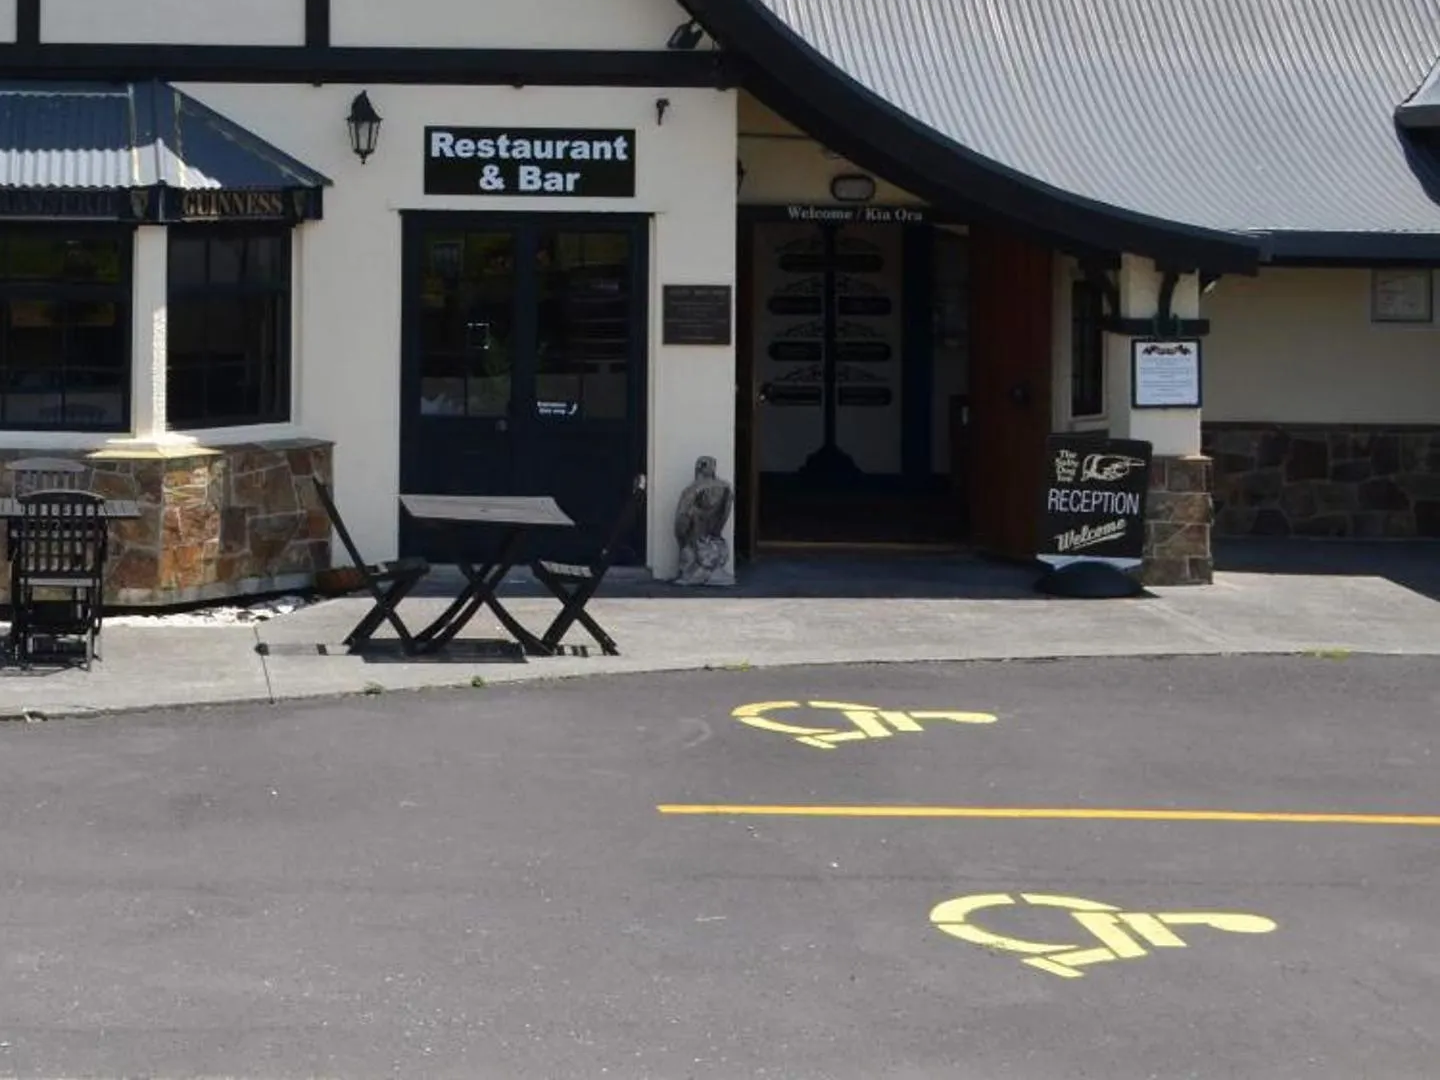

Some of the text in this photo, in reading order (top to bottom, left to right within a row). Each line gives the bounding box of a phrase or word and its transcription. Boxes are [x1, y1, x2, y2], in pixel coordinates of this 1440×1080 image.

[431, 131, 629, 160] Restaurant
[479, 164, 581, 191] & Bar
[182, 191, 284, 217] GUINNESS
[788, 206, 853, 219] Welcome
[865, 207, 891, 220] Kia
[895, 208, 923, 220] Ora
[1047, 488, 1140, 515] RECEPTION
[1054, 519, 1126, 552] Welcome
